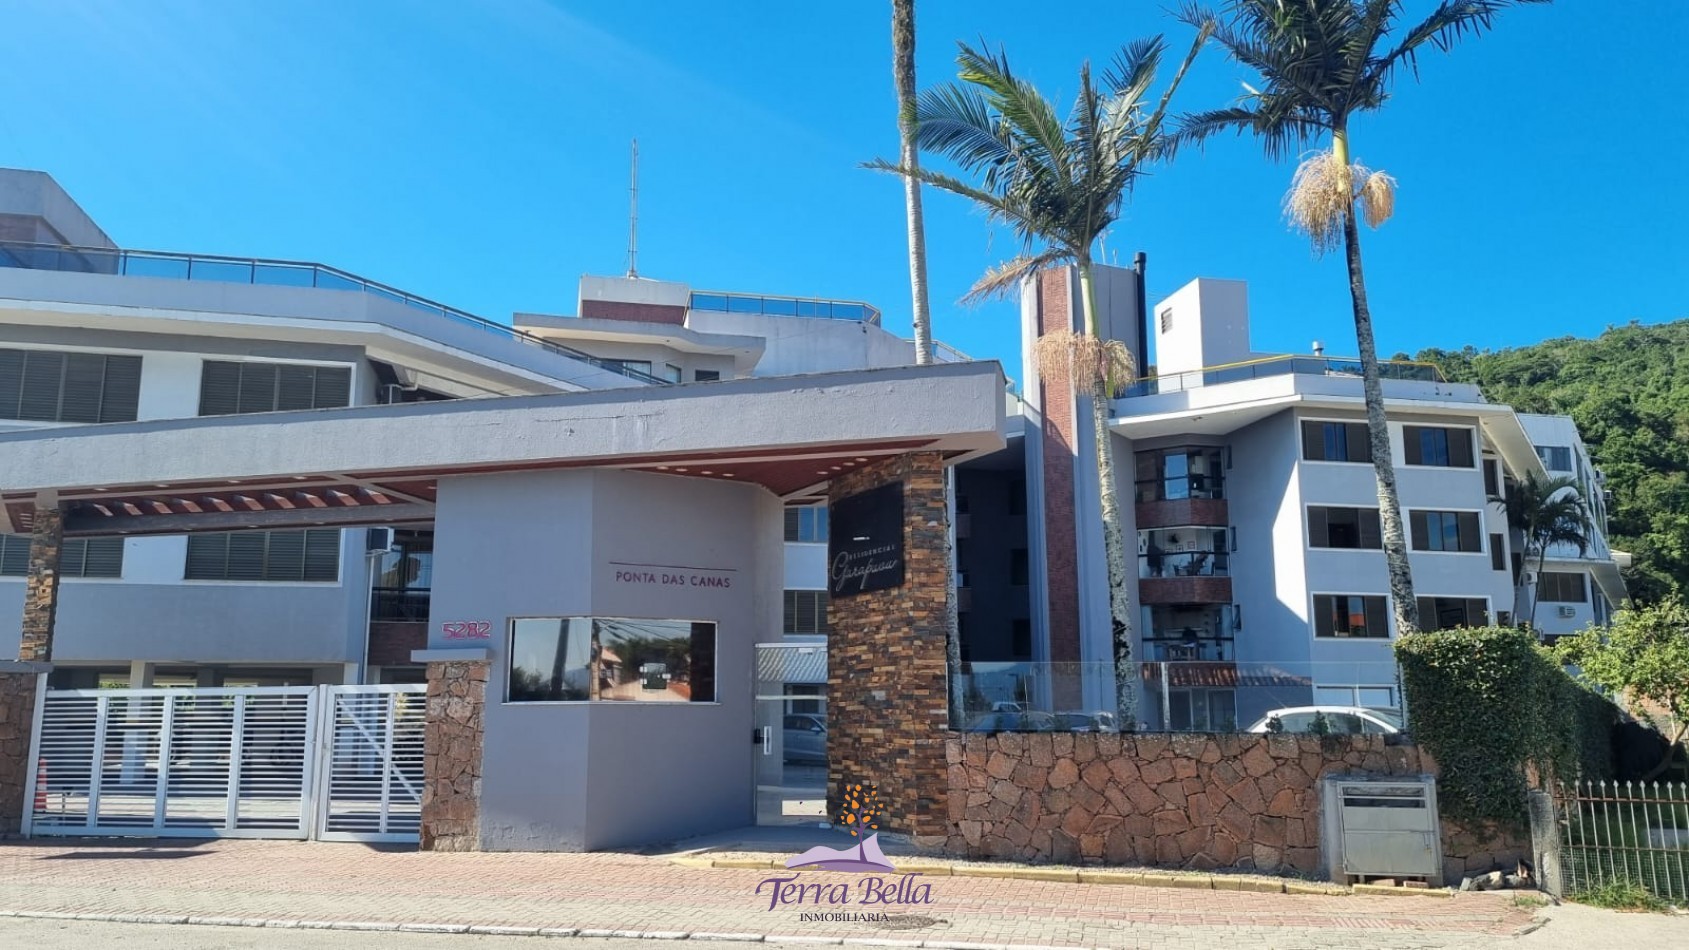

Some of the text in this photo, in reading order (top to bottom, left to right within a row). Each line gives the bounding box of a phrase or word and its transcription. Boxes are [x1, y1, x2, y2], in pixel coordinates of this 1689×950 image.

[616, 571, 731, 588] PONTA DAS CANAS
[441, 621, 491, 640] 5282
